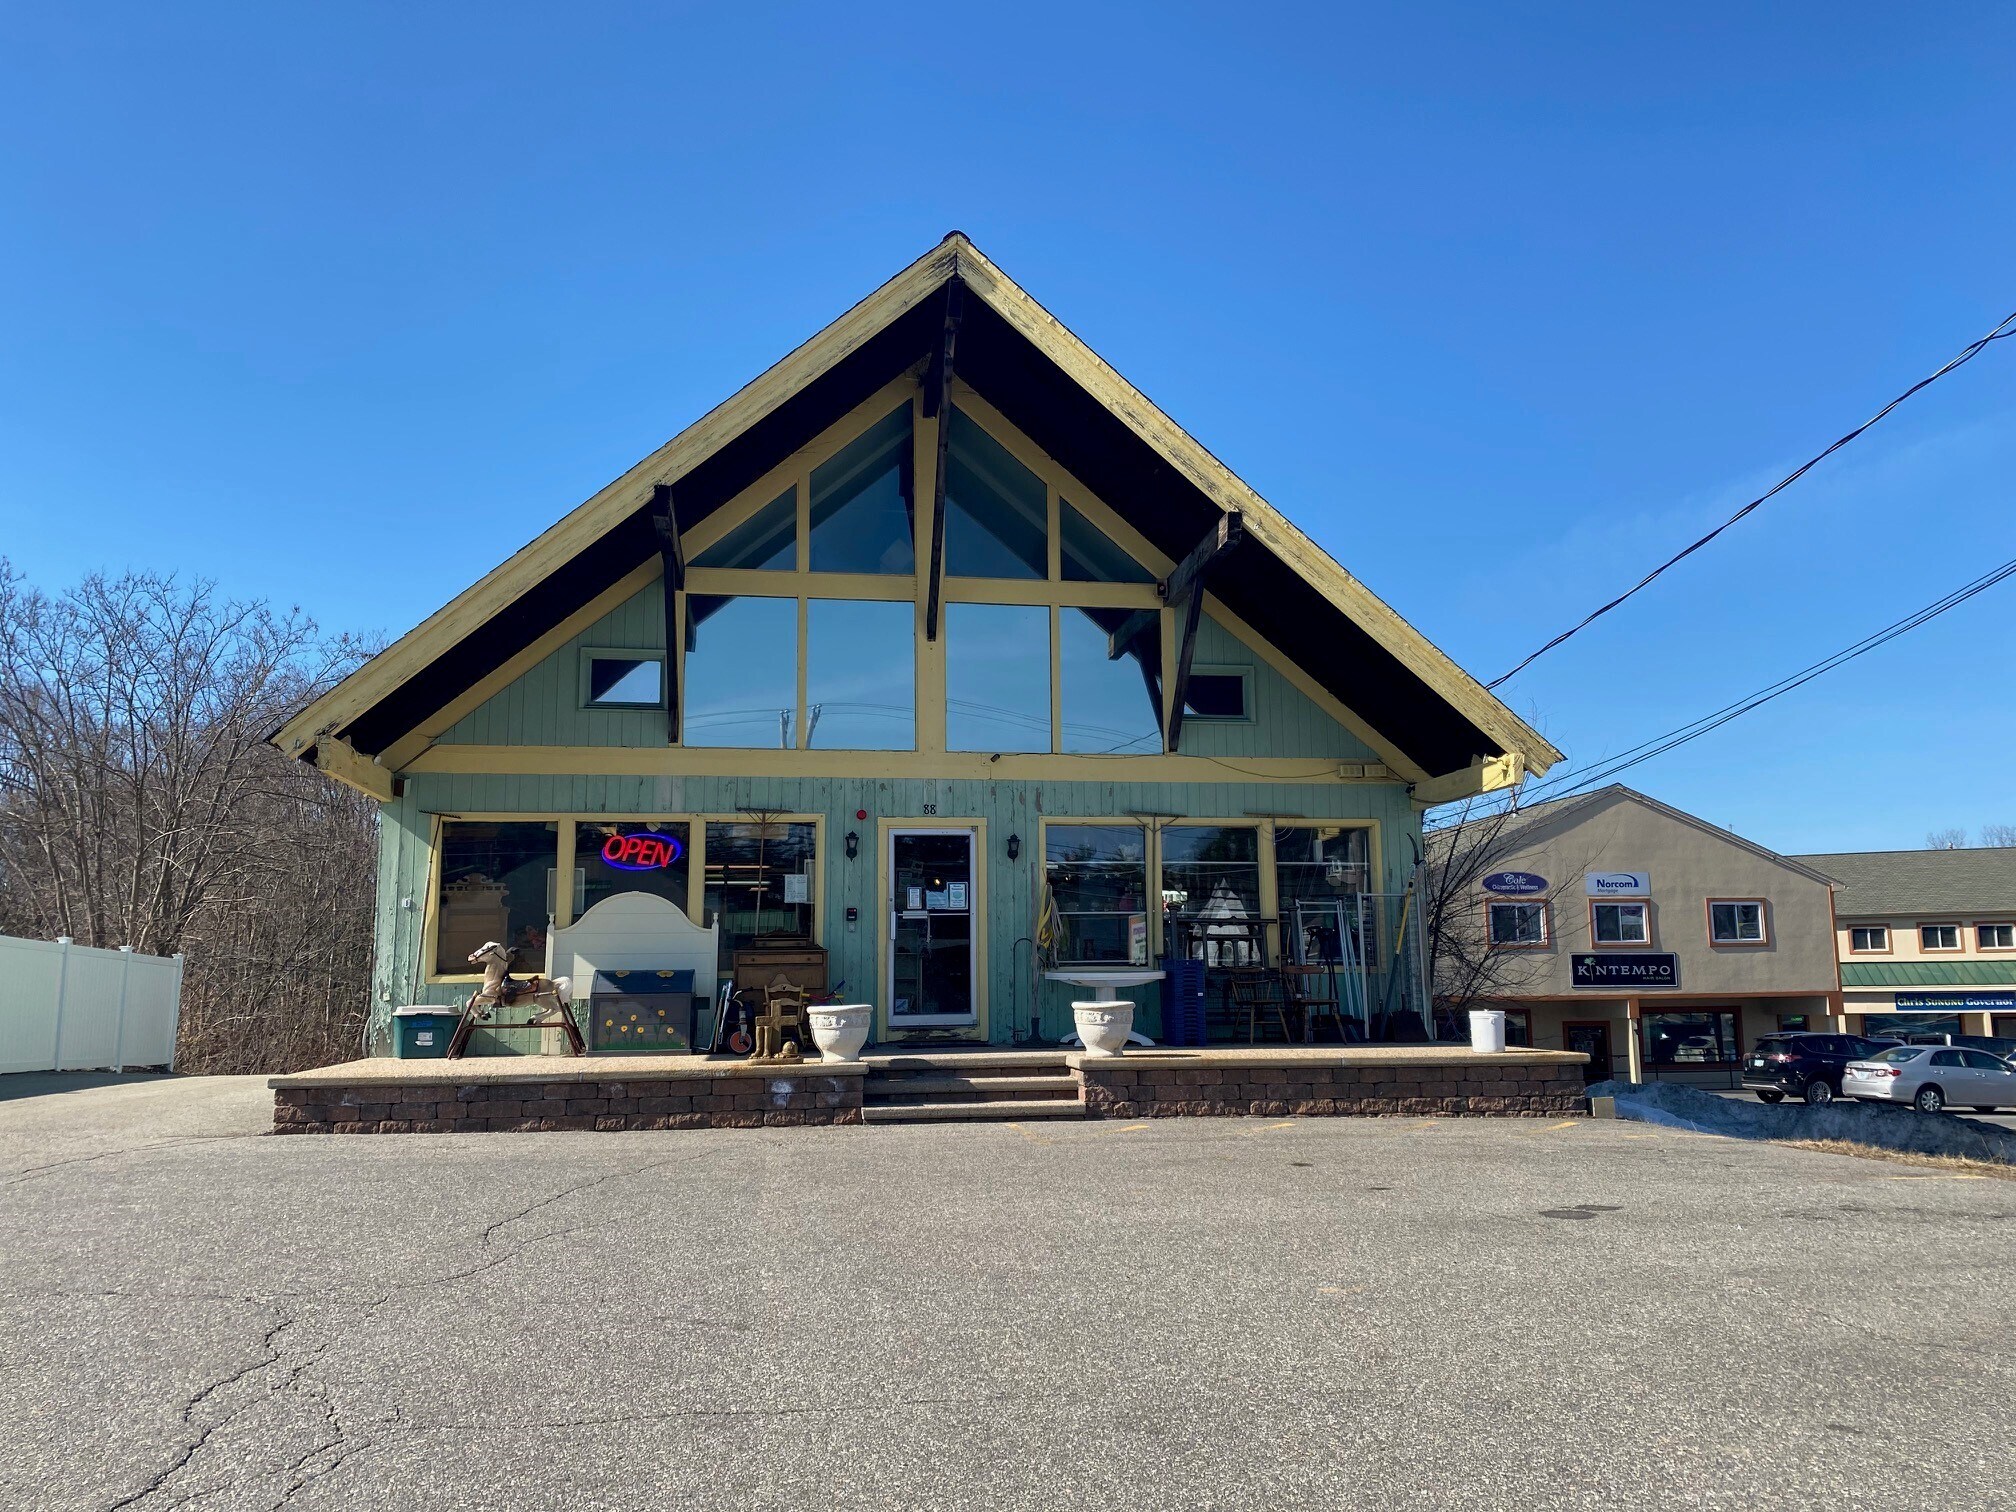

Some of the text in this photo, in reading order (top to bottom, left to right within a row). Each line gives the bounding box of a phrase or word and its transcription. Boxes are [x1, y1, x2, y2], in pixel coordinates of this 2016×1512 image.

[923, 804, 937, 815] 88
[604, 835, 674, 868] OPEN
[1503, 873, 1527, 885] Cole
[1596, 879, 1633, 888] Norcom
[1897, 997, 1924, 1006] Chris
[1965, 998, 2014, 1006] Governor
